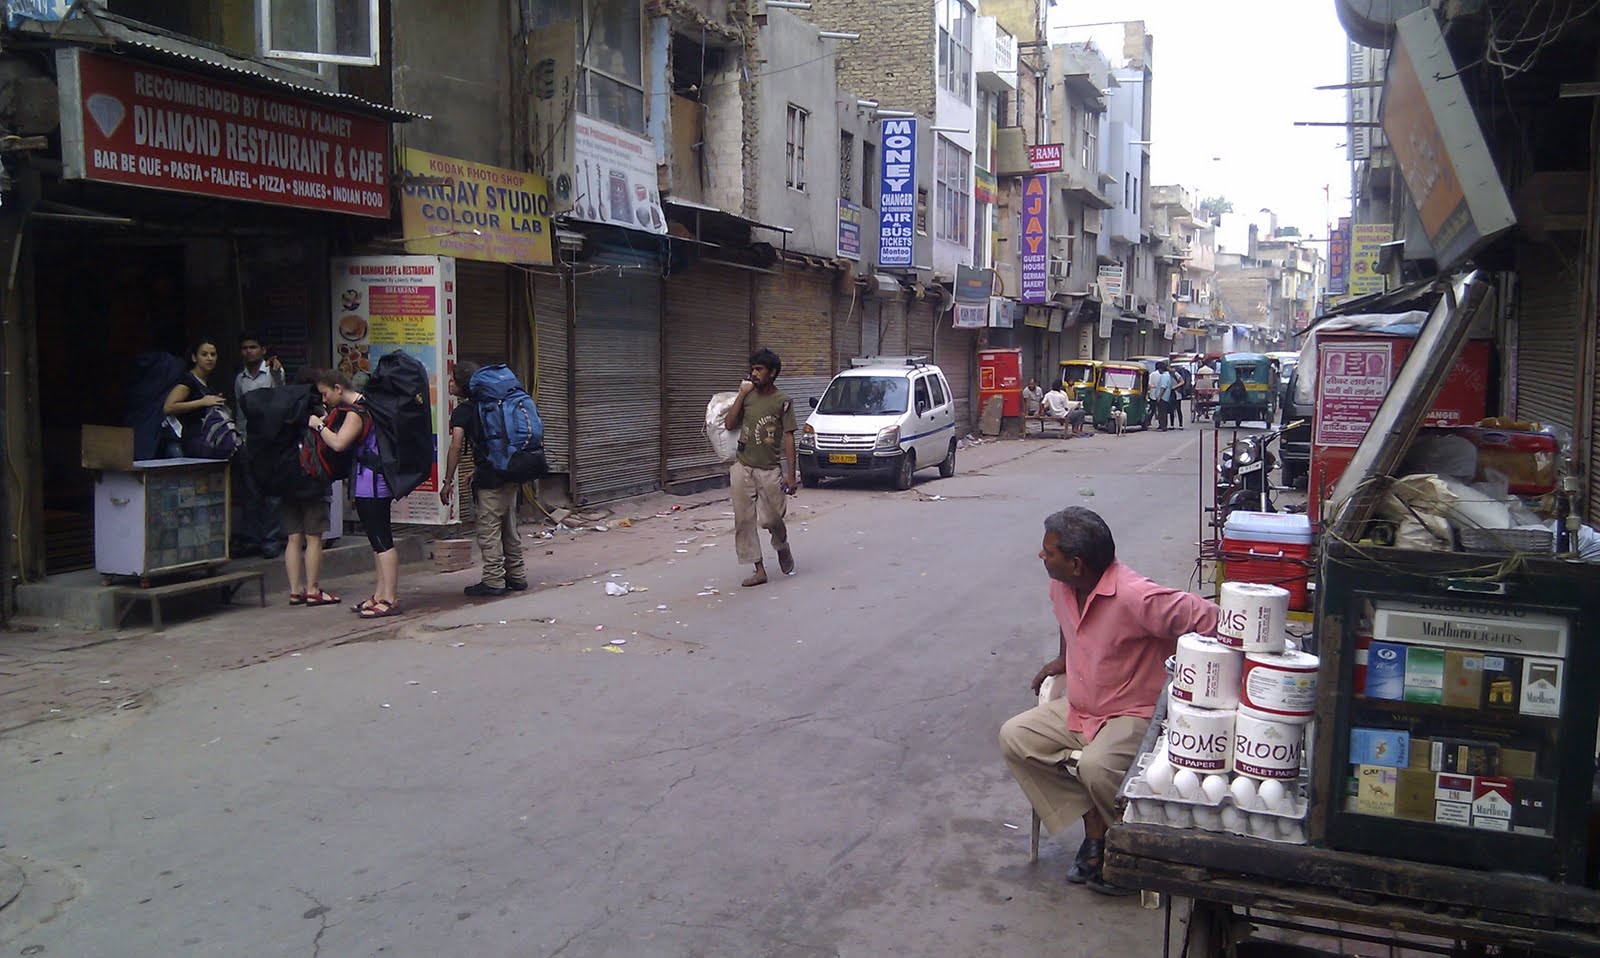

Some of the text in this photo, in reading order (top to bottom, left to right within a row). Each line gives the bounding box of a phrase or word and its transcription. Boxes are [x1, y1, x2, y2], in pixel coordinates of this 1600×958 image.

[134, 71, 352, 138] RECOMMENDED BY LONELY PLANET
[134, 104, 384, 185] DIAMOND RESTAURANT & CAFE
[884, 121, 911, 192] MONEY
[1036, 147, 1060, 160] RAMA
[94, 148, 383, 208] BAR BE QUE PASTA FALAFEL PIZZA SHAKES INDIAN FOOD
[429, 159, 524, 187] KODAK PHOTO SHOP
[486, 185, 549, 217] STUDIO
[881, 193, 913, 206] CHANGER
[421, 203, 543, 233] COLOUR LAB
[882, 213, 911, 222] AIR
[1025, 177, 1043, 253] AJAY
[881, 227, 911, 237] BUS
[881, 237, 912, 247] TICKETS
[882, 247, 909, 256] Montoo
[1023, 255, 1045, 263] GUEST
[349, 266, 361, 275] NEW
[361, 266, 384, 276] DIAMOND
[384, 266, 398, 275] CAFE
[402, 265, 434, 276] RESTAURANT
[1023, 263, 1045, 271] HOUSE
[1023, 272, 1045, 280] GERMAN
[385, 286, 419, 294] BREAKFAST
[1023, 280, 1045, 288] BAKERY
[1421, 620, 1523, 645] Marlboro LIGHTS
[1526, 689, 1556, 705] Marlboro
[1185, 760, 1216, 768] PAPER
[1242, 763, 1272, 776] TOILET
[1476, 802, 1509, 818] Marlboro
[1521, 799, 1543, 808] BLCK
